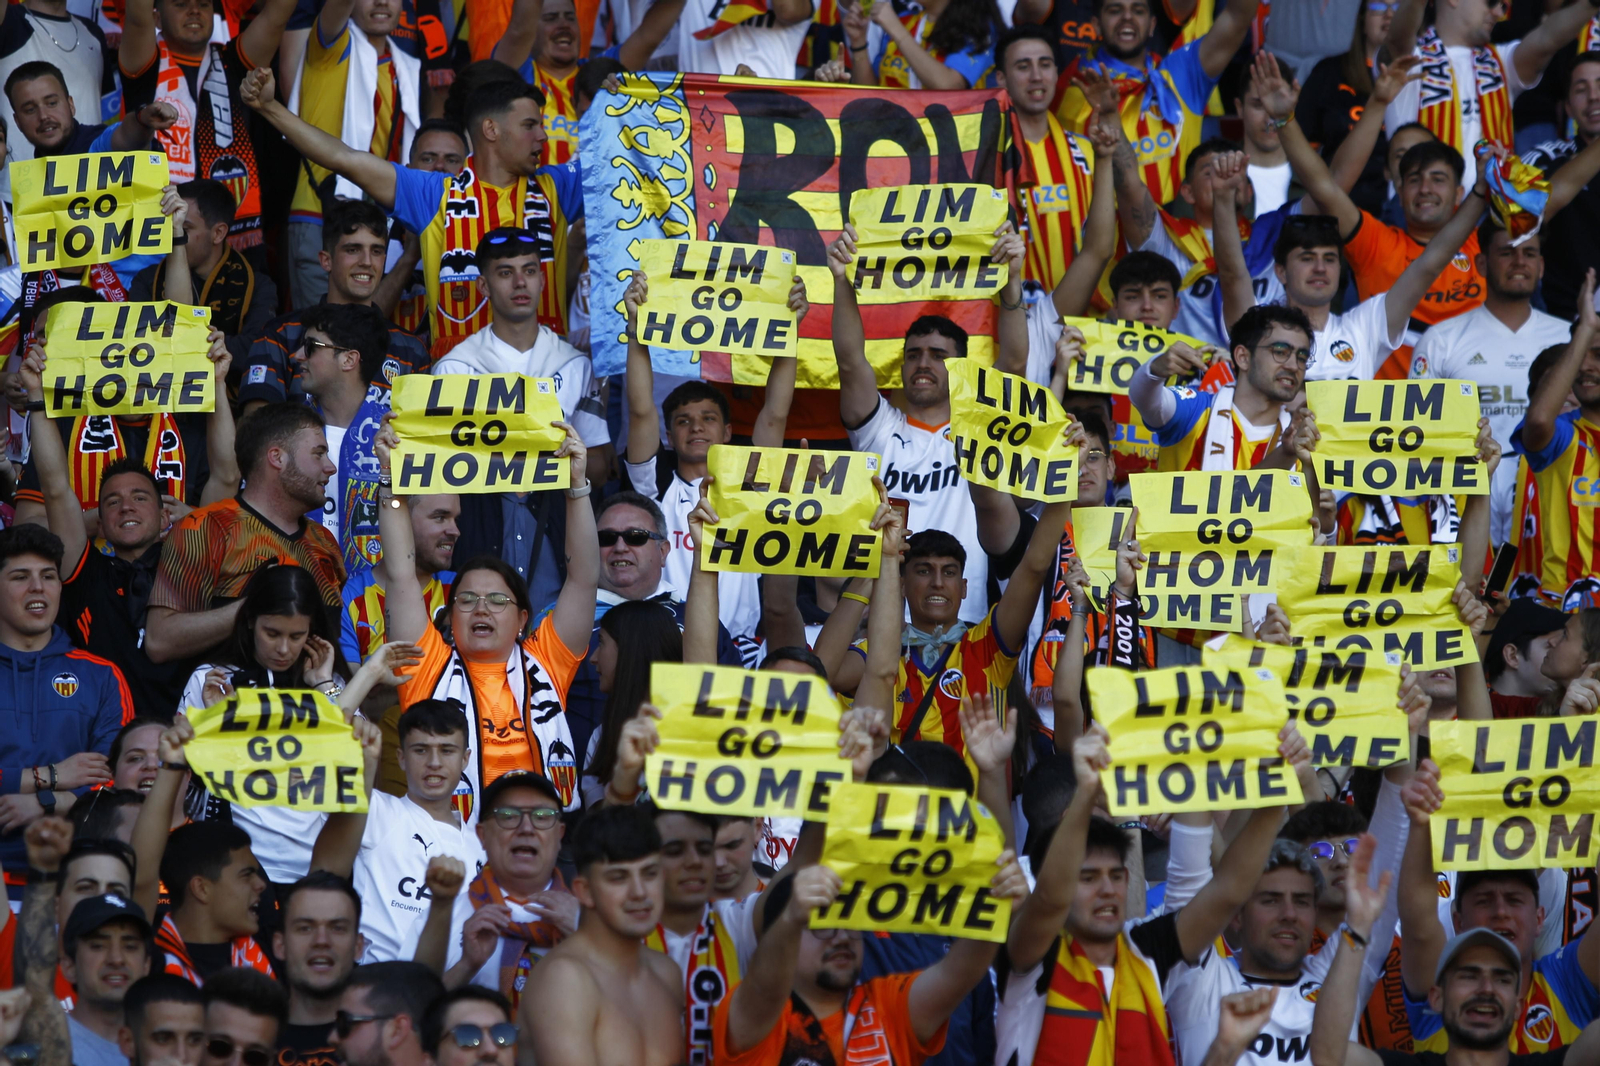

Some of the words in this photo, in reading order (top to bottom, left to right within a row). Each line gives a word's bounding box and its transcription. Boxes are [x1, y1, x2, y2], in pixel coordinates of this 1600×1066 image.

[43, 155, 135, 196] LIM
[67, 194, 118, 219] GO
[880, 188, 977, 223] LIM
[27, 217, 165, 264] HOME
[901, 227, 952, 250] GO
[670, 244, 768, 285] LIM
[853, 256, 999, 289] HOME
[691, 286, 742, 311] GO
[76, 305, 178, 340] LIM
[644, 312, 791, 349] HOME
[101, 343, 155, 368] GO
[1117, 331, 1165, 353] GO
[52, 371, 208, 410] HOME
[425, 378, 525, 416] LIM
[976, 368, 1047, 423] LIM
[1343, 383, 1445, 422] LIM
[450, 420, 507, 446] GO
[987, 416, 1032, 446] GO
[1369, 425, 1424, 453] GO
[399, 451, 559, 487] HOME
[740, 452, 851, 495] LIM
[883, 461, 960, 494] bwin
[955, 436, 1073, 496] HOME
[1324, 456, 1478, 490] HOME
[765, 498, 823, 525] GO
[1170, 474, 1274, 514] LIM
[708, 528, 876, 570] HOME
[1197, 518, 1253, 544] GO
[1145, 550, 1274, 588] HOM
[1315, 551, 1431, 595] LIM
[1343, 599, 1404, 628] GO
[1115, 615, 1133, 665] 2001
[219, 693, 320, 732] LIM
[693, 671, 812, 725] LIM
[1134, 671, 1245, 718] LIM
[247, 735, 302, 762] GO
[717, 727, 782, 759] GO
[1164, 721, 1225, 755] GO
[1471, 721, 1597, 774] LIM
[205, 765, 358, 806] HOME
[658, 760, 844, 812] HOME
[1115, 757, 1288, 806] HOME
[1502, 775, 1571, 808] GO
[869, 793, 978, 844] LIM
[1442, 813, 1596, 862] HOM
[890, 848, 953, 878] GO
[818, 880, 999, 931] HOME
